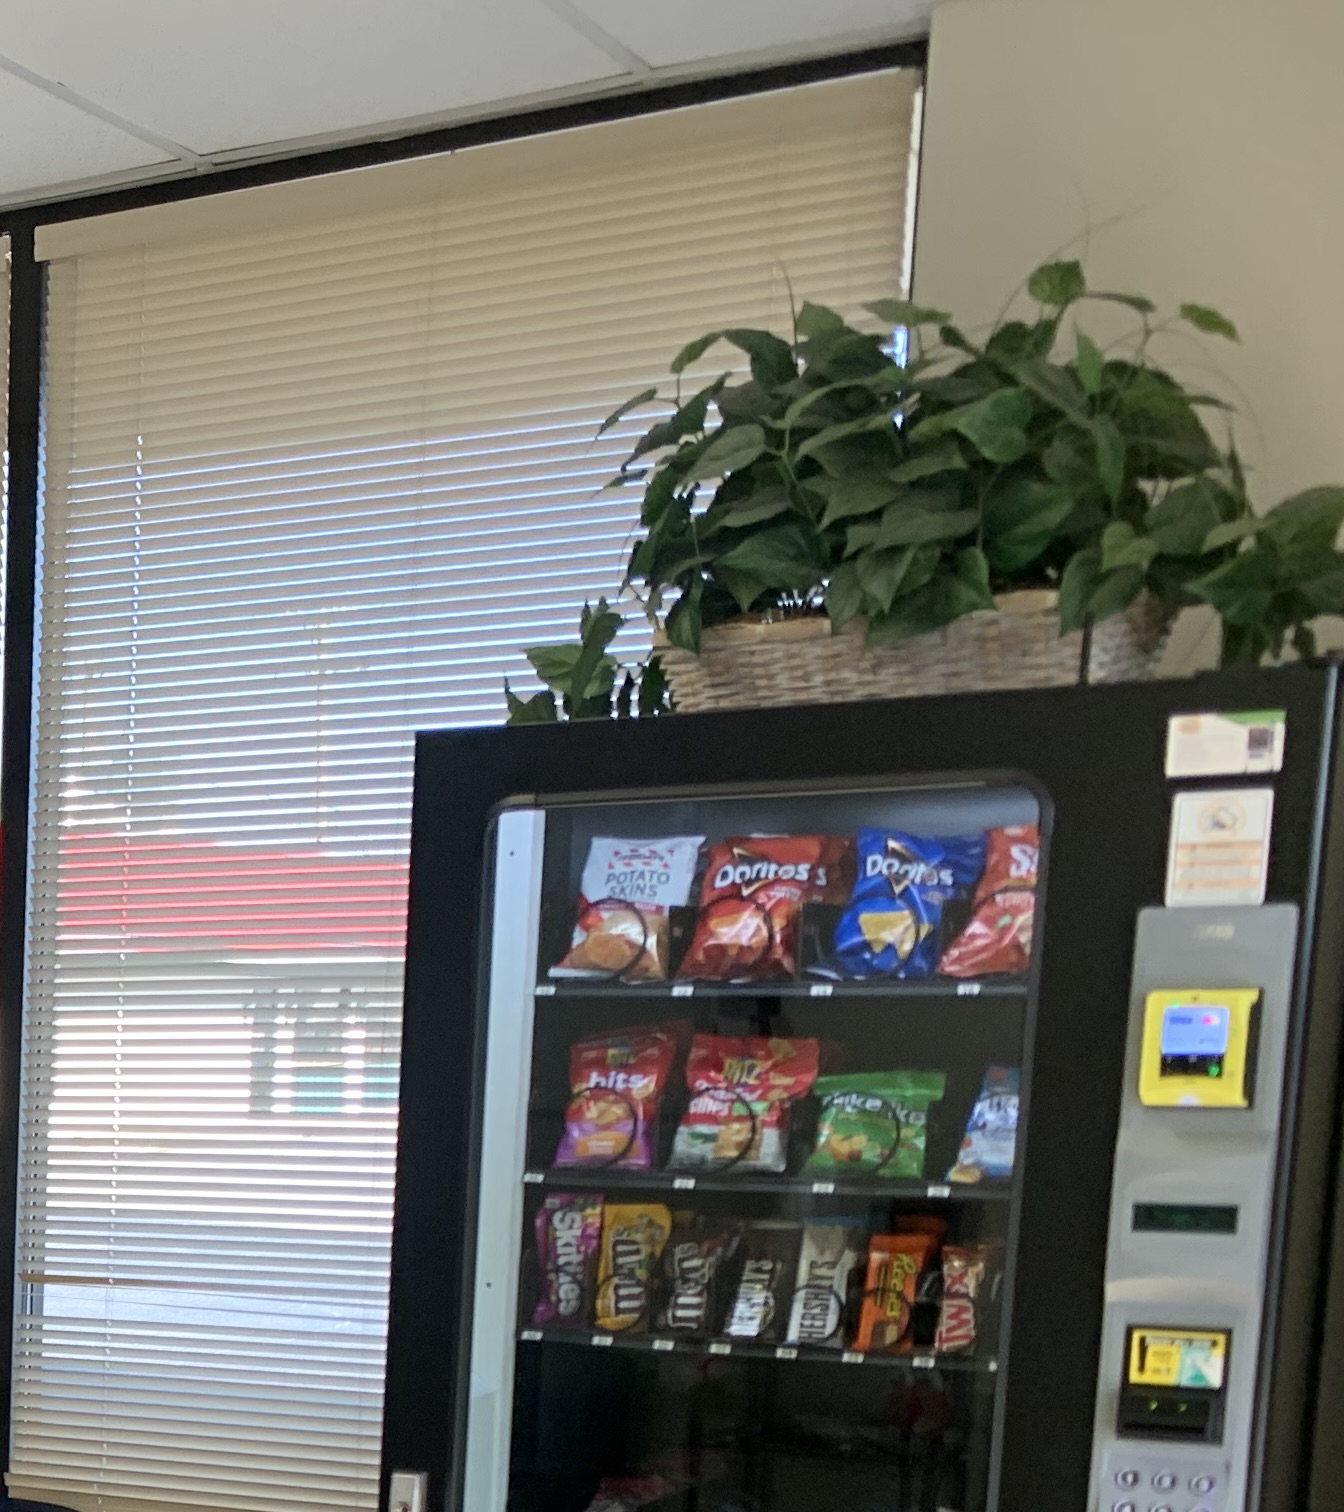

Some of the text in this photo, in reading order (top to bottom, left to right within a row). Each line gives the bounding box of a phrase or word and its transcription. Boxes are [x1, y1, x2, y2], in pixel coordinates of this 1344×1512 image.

[604, 868, 670, 887] POTATO
[714, 863, 811, 890] Doritos
[865, 853, 955, 887] Doritos
[608, 882, 659, 899] SKINS
[586, 1071, 648, 1090] hits
